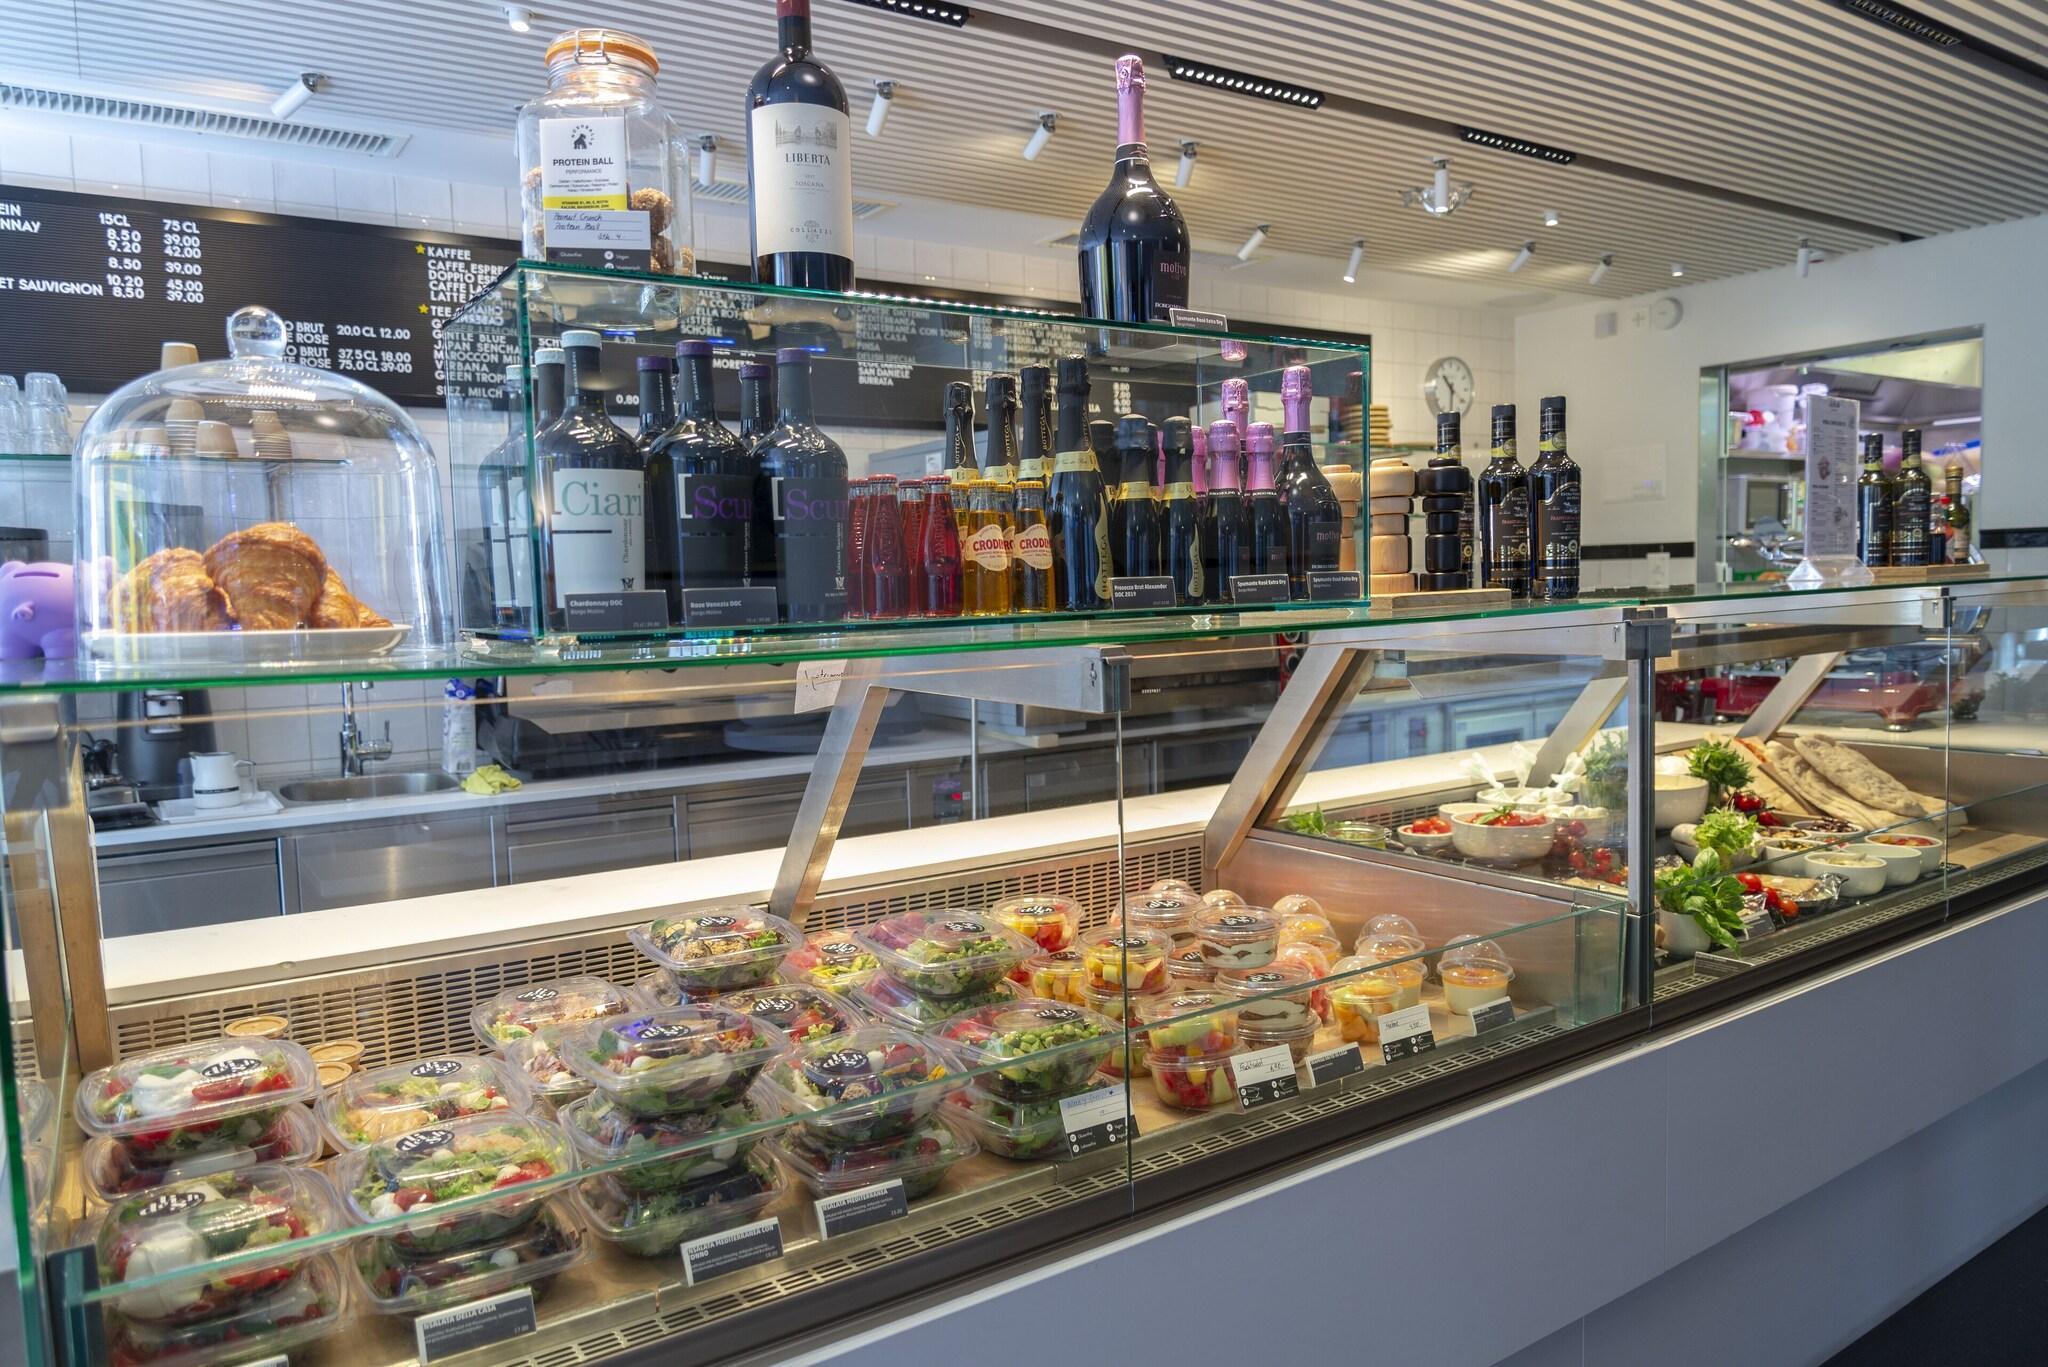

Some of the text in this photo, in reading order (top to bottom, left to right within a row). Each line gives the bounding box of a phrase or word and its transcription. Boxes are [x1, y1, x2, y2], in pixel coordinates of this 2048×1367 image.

[182, 221, 200, 234] CL
[106, 228, 142, 242] 8.50
[163, 234, 200, 248] 39.00
[107, 240, 142, 254] 9.20
[164, 246, 202, 259] 42.00
[427, 246, 472, 260] KAFFEE
[108, 257, 142, 270] 8.50
[164, 262, 202, 276] 39.00
[106, 274, 144, 288] 10.20
[428, 270, 474, 283] DOPPIO
[18, 280, 104, 297] SAUVIGNON
[112, 286, 144, 300] 8.50
[166, 278, 204, 292] 45.00
[429, 280, 466, 293] CAFFE
[166, 290, 204, 304] 39.00
[430, 291, 466, 303] LATTE
[430, 306, 452, 318] TEE
[296, 322, 325, 334] BRUT
[362, 326, 377, 338] CL
[380, 328, 411, 340] 12.00
[296, 334, 330, 345] ROSE
[479, 332, 507, 344] BLUE
[300, 346, 329, 358] BRUT
[338, 348, 362, 360] 37.5
[364, 350, 378, 362] CL
[380, 351, 412, 363] 18.00
[477, 343, 520, 354] SENCHA
[300, 358, 332, 369] ROSE
[338, 360, 364, 371] 75.0
[366, 361, 380, 372] CL
[435, 360, 490, 373] VRBANA
[876, 369, 911, 379] DANIELE
[468, 386, 503, 398] MILCH
[570, 600, 609, 608] Chardonnay
[762, 1225, 774, 1234] CON
[478, 1304, 497, 1316] CASA
